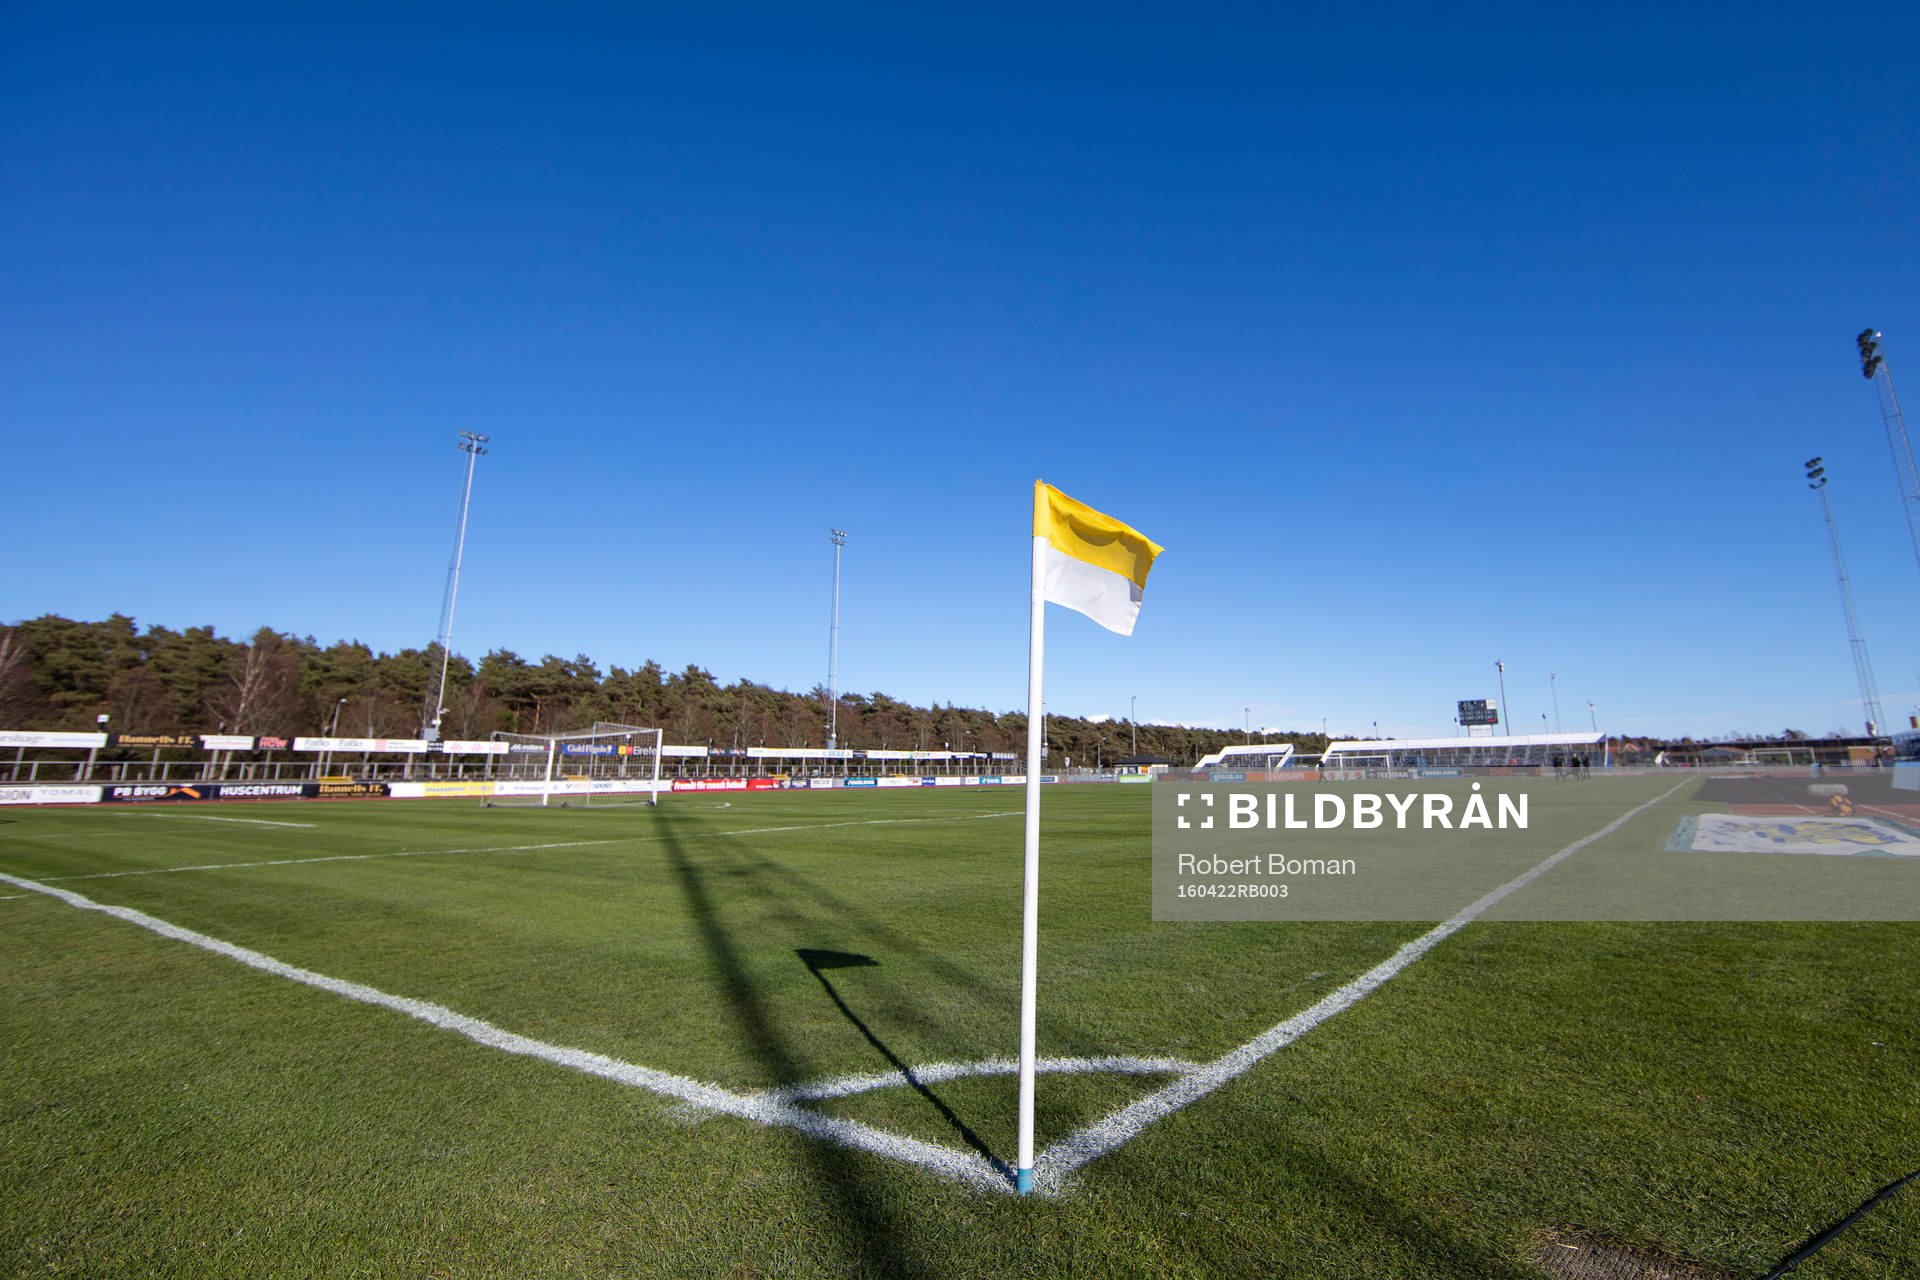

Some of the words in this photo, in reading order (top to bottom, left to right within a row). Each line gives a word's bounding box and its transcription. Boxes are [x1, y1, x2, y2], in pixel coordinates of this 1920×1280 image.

[113, 787, 132, 796] PB
[134, 787, 168, 796] BYGG
[219, 785, 303, 796] HUSCENTRUM
